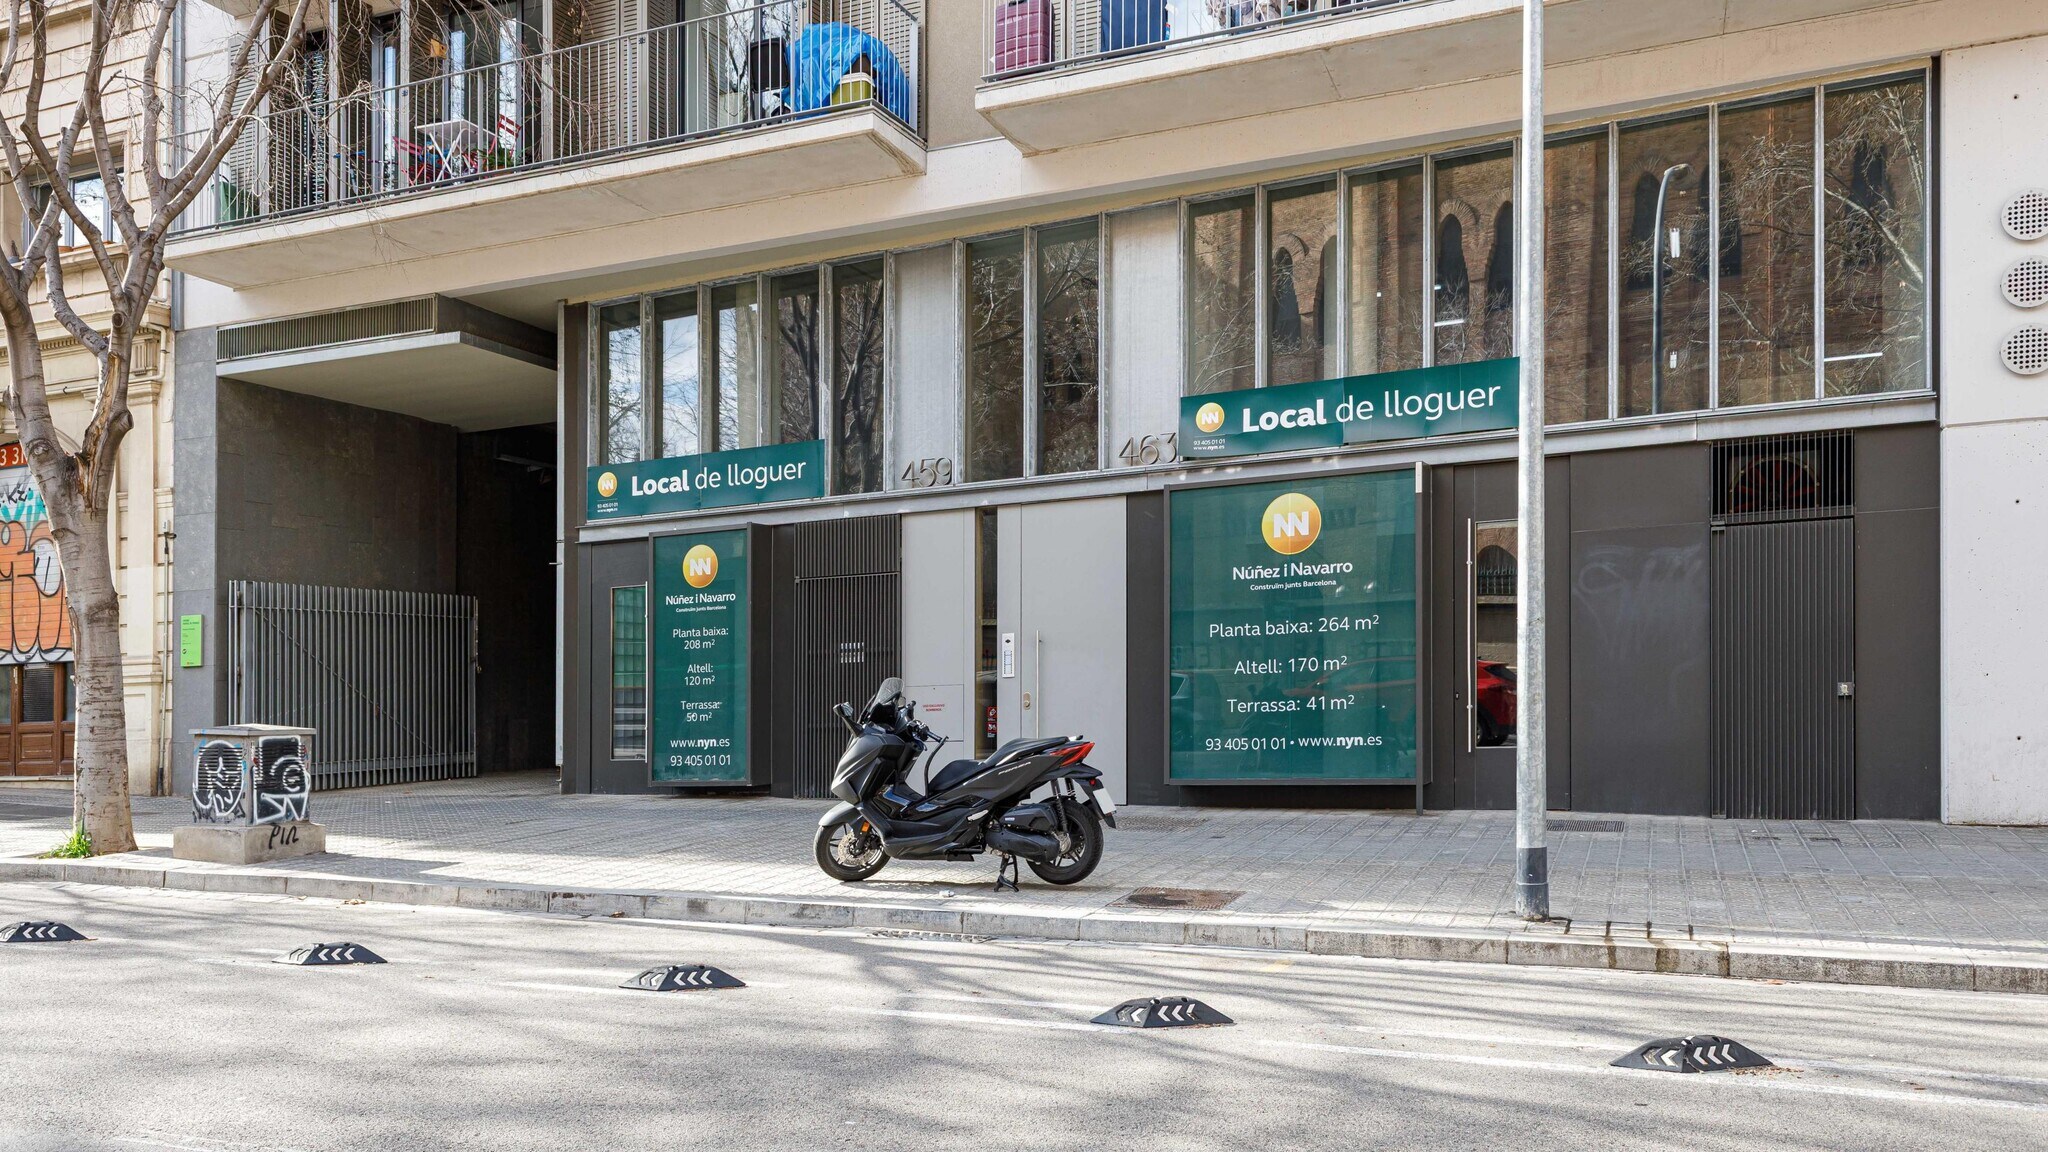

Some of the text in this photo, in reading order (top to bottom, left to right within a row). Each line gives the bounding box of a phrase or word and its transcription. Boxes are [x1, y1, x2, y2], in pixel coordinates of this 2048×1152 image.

[1242, 385, 1501, 433] Local de lloguer
[1118, 432, 1177, 466] 463
[631, 461, 807, 497] Local de lloguer
[901, 457, 953, 488] 459
[1232, 561, 1354, 581] Núñez i Navarro
[1285, 581, 1302, 590] junts
[1302, 579, 1337, 587] Barcelona
[665, 592, 736, 606] Núñez i Navarro
[672, 626, 729, 638] Planta baixa:
[1209, 614, 1380, 638] Planta baixa: 264 m²
[684, 638, 716, 650] 208 m²
[687, 663, 714, 674] Altell:
[1233, 655, 1348, 675] Altell: 170 m²
[684, 675, 716, 686] 120 m²
[680, 700, 720, 710] Terrassa:
[1226, 694, 1355, 713] Terrassa: 41 m²
[686, 711, 713, 722] 50 m²
[670, 738, 730, 750] www.nyn.es
[1205, 735, 1383, 751] 93 405 01 01 www.nyn.es
[670, 754, 731, 767] 93 405 01 01
